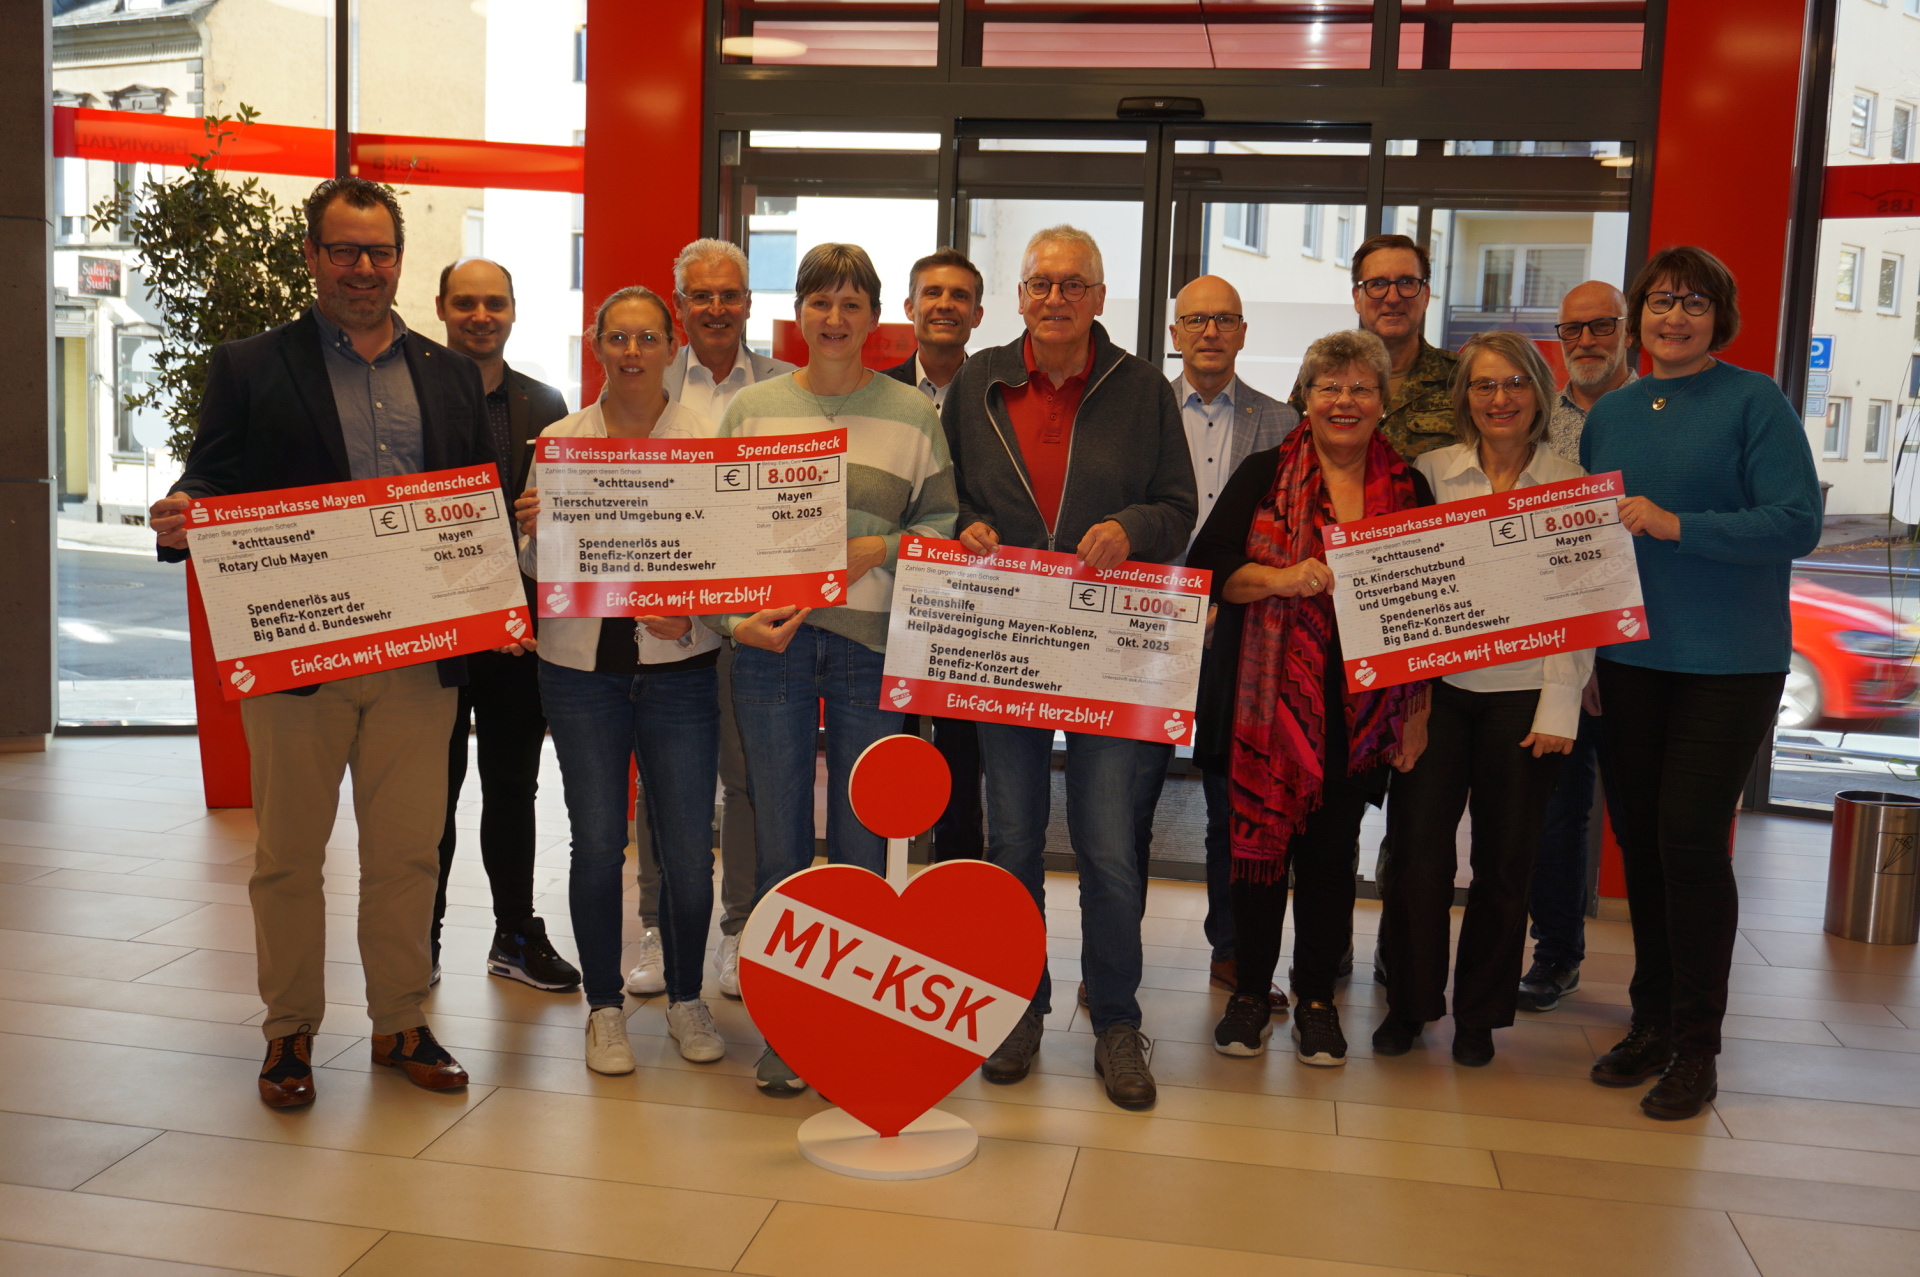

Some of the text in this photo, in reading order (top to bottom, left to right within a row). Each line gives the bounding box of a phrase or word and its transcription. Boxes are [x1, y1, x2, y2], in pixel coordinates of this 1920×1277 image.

[83, 261, 115, 277] Sakura
[86, 276, 112, 290] Sushi
[566, 448, 714, 463] Kreissparkasse Mayen
[737, 436, 840, 457] Spendenscheck
[723, 468, 740, 487] €
[767, 464, 828, 483] 8.000,-
[387, 472, 491, 499] Spendenscheck
[1507, 479, 1615, 511] Spendenscheck
[214, 493, 366, 521] Kreissparkasse Mayen
[552, 496, 648, 507] Tierschutzverein
[777, 491, 812, 503] Mayen
[379, 510, 398, 530] €
[423, 503, 487, 525] 8.000,-
[552, 509, 705, 524] Mayen und Umgebung e.V.
[771, 506, 822, 520] Okt. 2025
[1544, 509, 1609, 533] 8.000,-
[196, 532, 220, 541] Zahlen
[232, 528, 252, 537] gegen
[252, 525, 274, 533] diesen
[274, 521, 298, 530] Scheck
[438, 529, 473, 542] Mayen
[1350, 508, 1486, 542] Kreissparkasse Mayen
[1498, 521, 1516, 539] €
[578, 537, 680, 552] Spendenerlös aus
[1334, 551, 1354, 560] Zahlen
[1365, 546, 1382, 554] gegen
[1382, 542, 1401, 550] diesen
[1401, 537, 1422, 546] Scheck
[1555, 533, 1592, 547] Mayen
[218, 550, 328, 573] Rotary Club Mayen
[433, 544, 484, 562] Okt. 2025
[579, 549, 692, 564] Benefiz-Konzert der
[927, 547, 1073, 576] Kreissparkasse Mayen
[1549, 549, 1602, 566] Okt. 2025
[579, 559, 716, 575] Big Band d. Bundeswehr
[904, 564, 925, 572] Zahlen
[978, 572, 1000, 581] Scheck
[1352, 577, 1368, 587] Dt.
[1370, 555, 1465, 584] Kinderschutzbund
[607, 584, 772, 609] Einfach mit Herzblut!
[1078, 588, 1097, 606] €
[1355, 573, 1456, 600] Ortsverband Mayen
[1359, 583, 1459, 611] und Umgebung e.V.
[246, 591, 350, 616] Spendenerlös aus
[910, 593, 975, 611] Lebenshilfe
[1122, 594, 1186, 618] 1.000,-
[1379, 599, 1472, 624] Spendenerlös aus
[250, 601, 365, 628] Benefiz-Konzert der
[253, 609, 392, 642] Big Band d. Bundeswehr
[909, 605, 1097, 639] Kreisvereinigung Mayen-Koblenz,
[1129, 618, 1165, 632] Mayen
[1381, 608, 1485, 635] Benefiz-Konzert der
[907, 619, 1090, 651] Heilpädagogische Einrichtungen
[1383, 615, 1510, 646] Big Band d. Bundeswehr
[290, 628, 457, 676] Einfach mit Herzblut!
[930, 643, 1029, 664] Spendenerlös aus
[1116, 636, 1169, 651] Okt. 2025
[1407, 627, 1565, 672] Einfach mit Herzblut!
[929, 655, 1040, 677] Benefiz-Konzert der
[927, 666, 1062, 692] Big Band d. Bundeswehr
[946, 693, 1114, 729] Einfach mit Herzblut!
[764, 908, 997, 1043] MY-KSK
